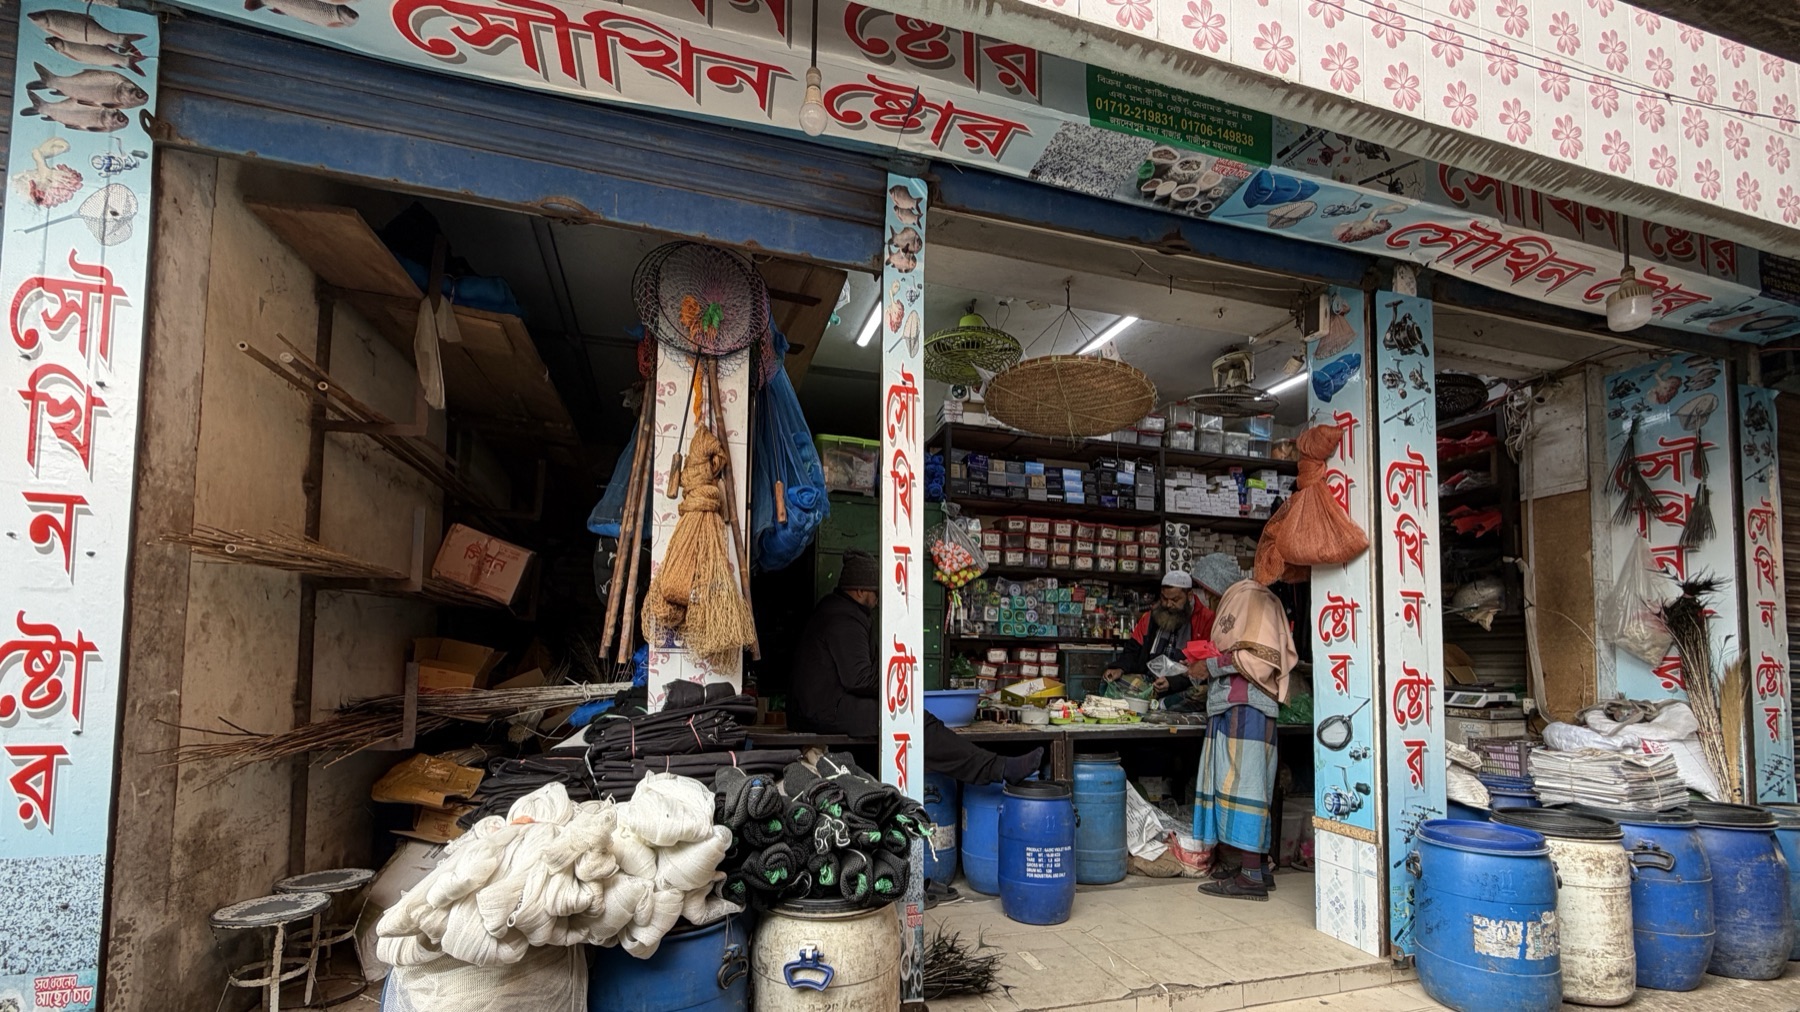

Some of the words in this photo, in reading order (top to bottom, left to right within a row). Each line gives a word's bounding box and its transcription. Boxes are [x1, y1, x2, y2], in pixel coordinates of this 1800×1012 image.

[1181, 119, 1254, 147] 01706-149838
[35, 977, 50, 991] সব
[50, 974, 78, 990] ধরনের
[36, 989, 71, 1008] মাছের
[73, 987, 94, 1006] চার
